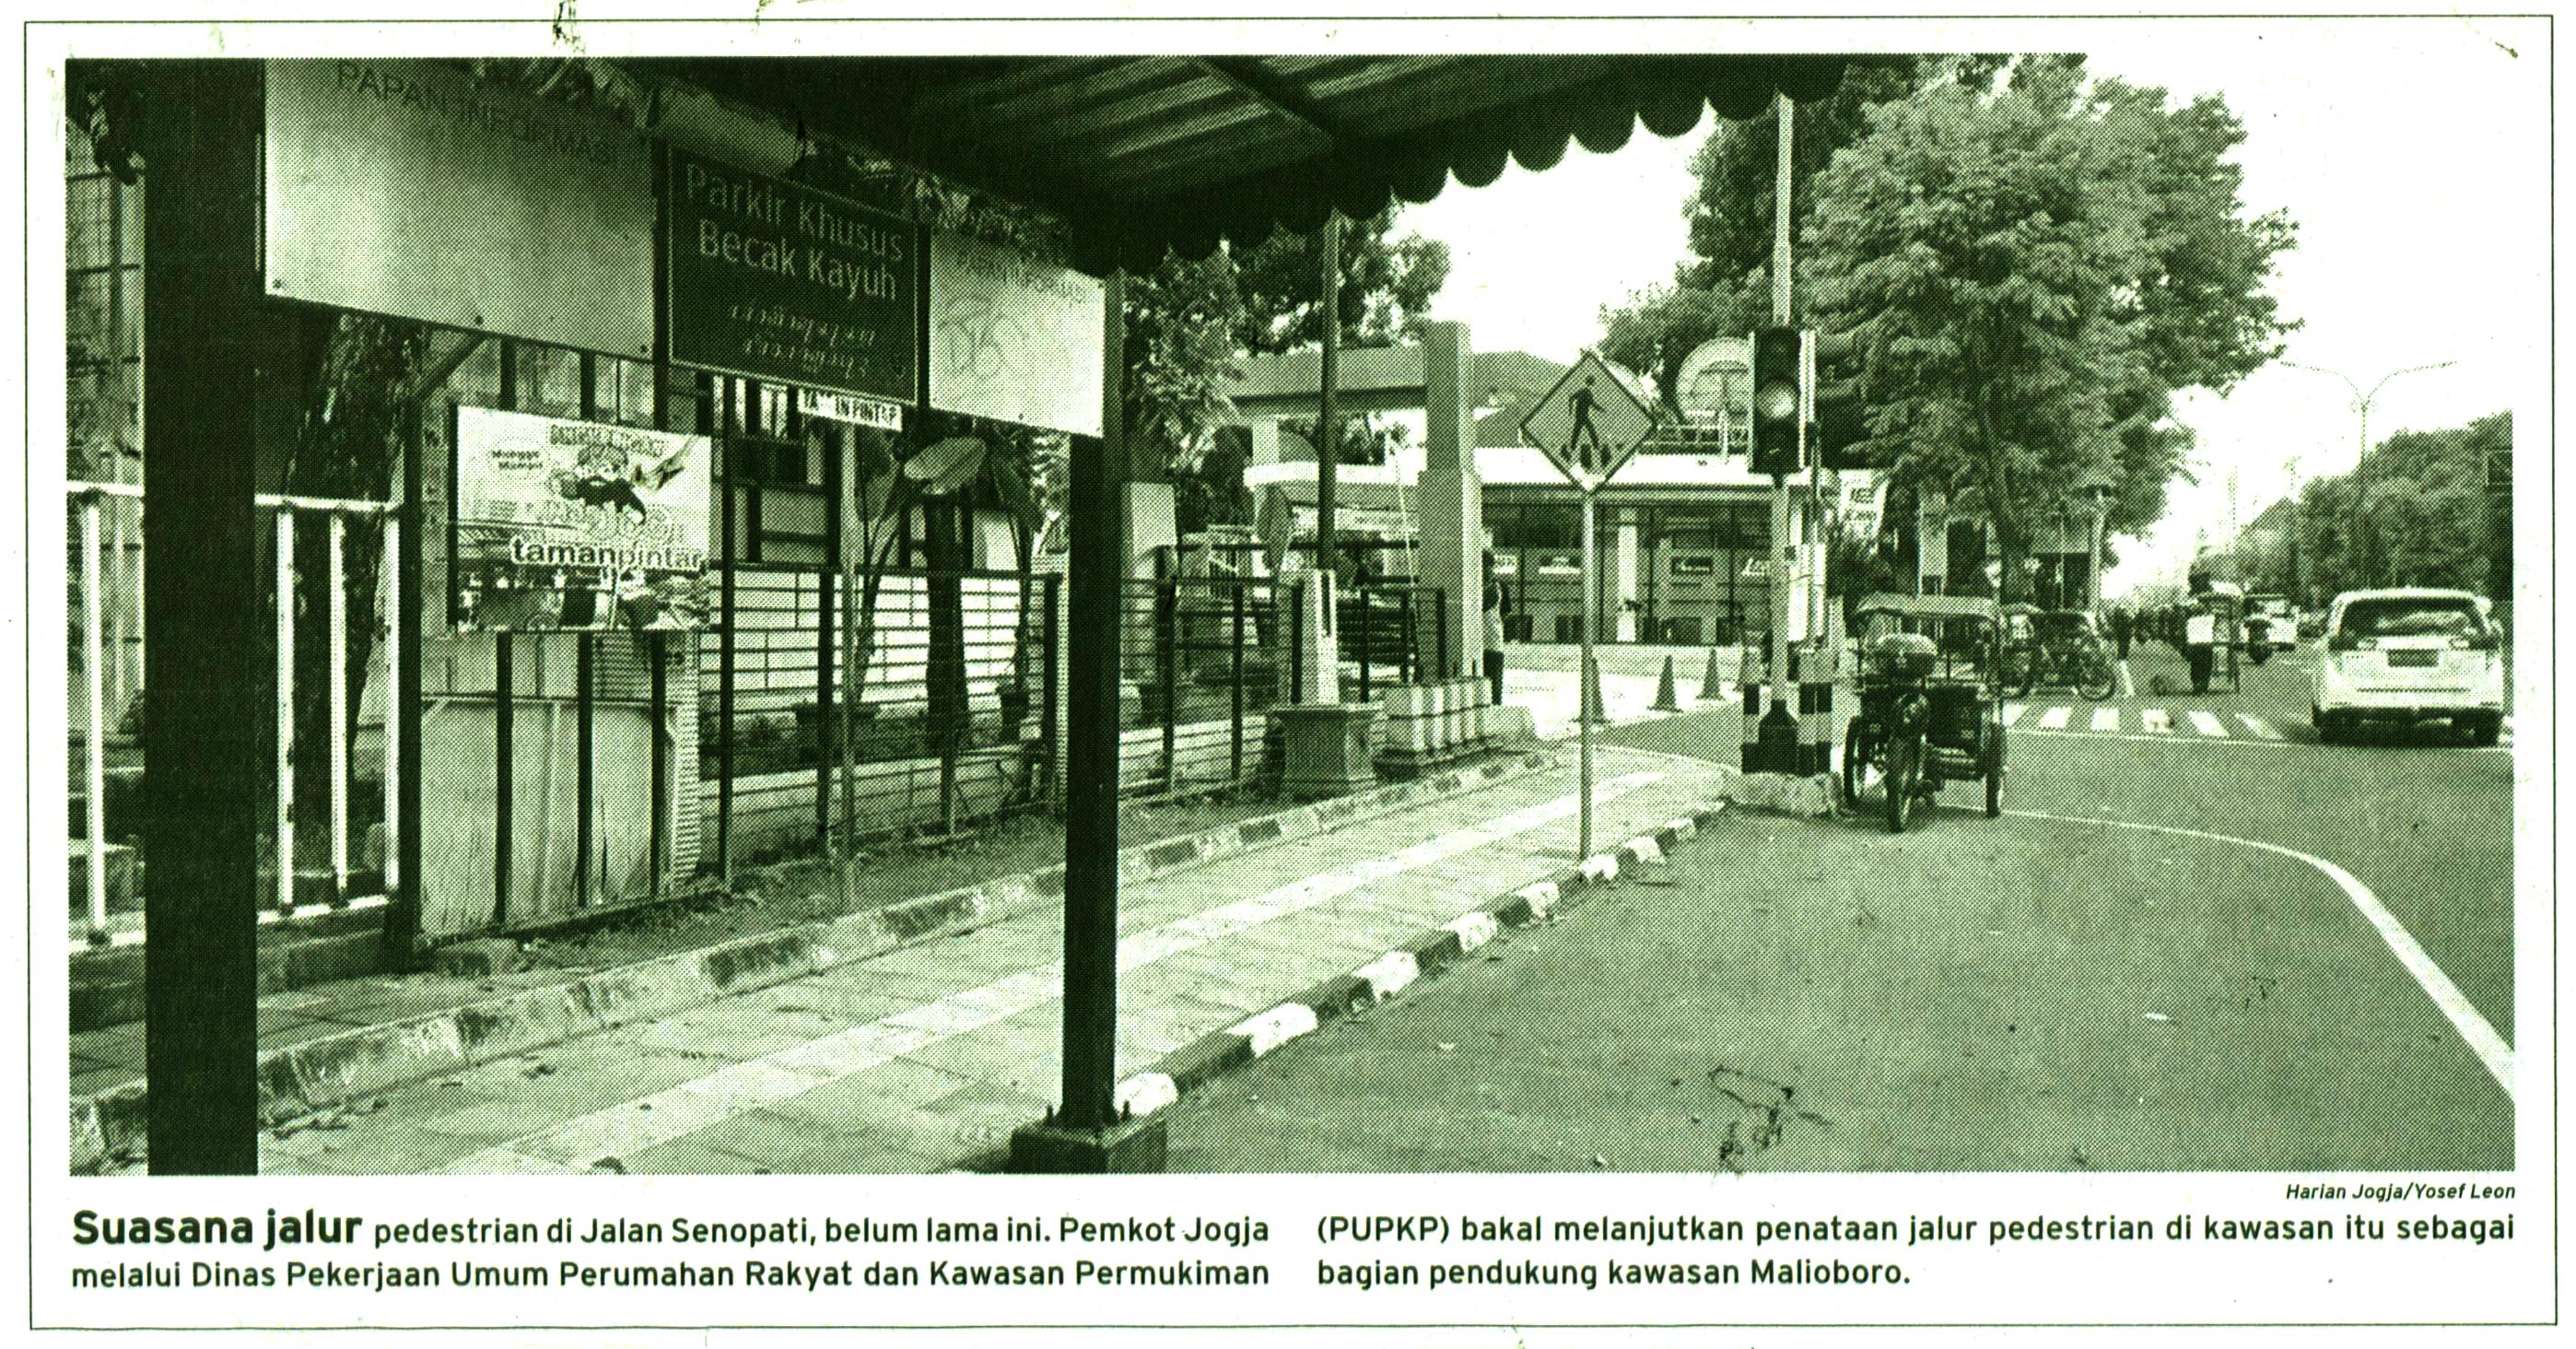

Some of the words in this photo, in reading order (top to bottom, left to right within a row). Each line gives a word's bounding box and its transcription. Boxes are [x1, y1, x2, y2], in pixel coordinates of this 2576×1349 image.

[335, 62, 448, 117] PAPAN
[685, 162, 785, 227] Parkir
[798, 194, 904, 264] Khusus
[698, 217, 796, 277] Becak
[808, 249, 897, 303] Kayuh
[802, 387, 850, 416] TAN
